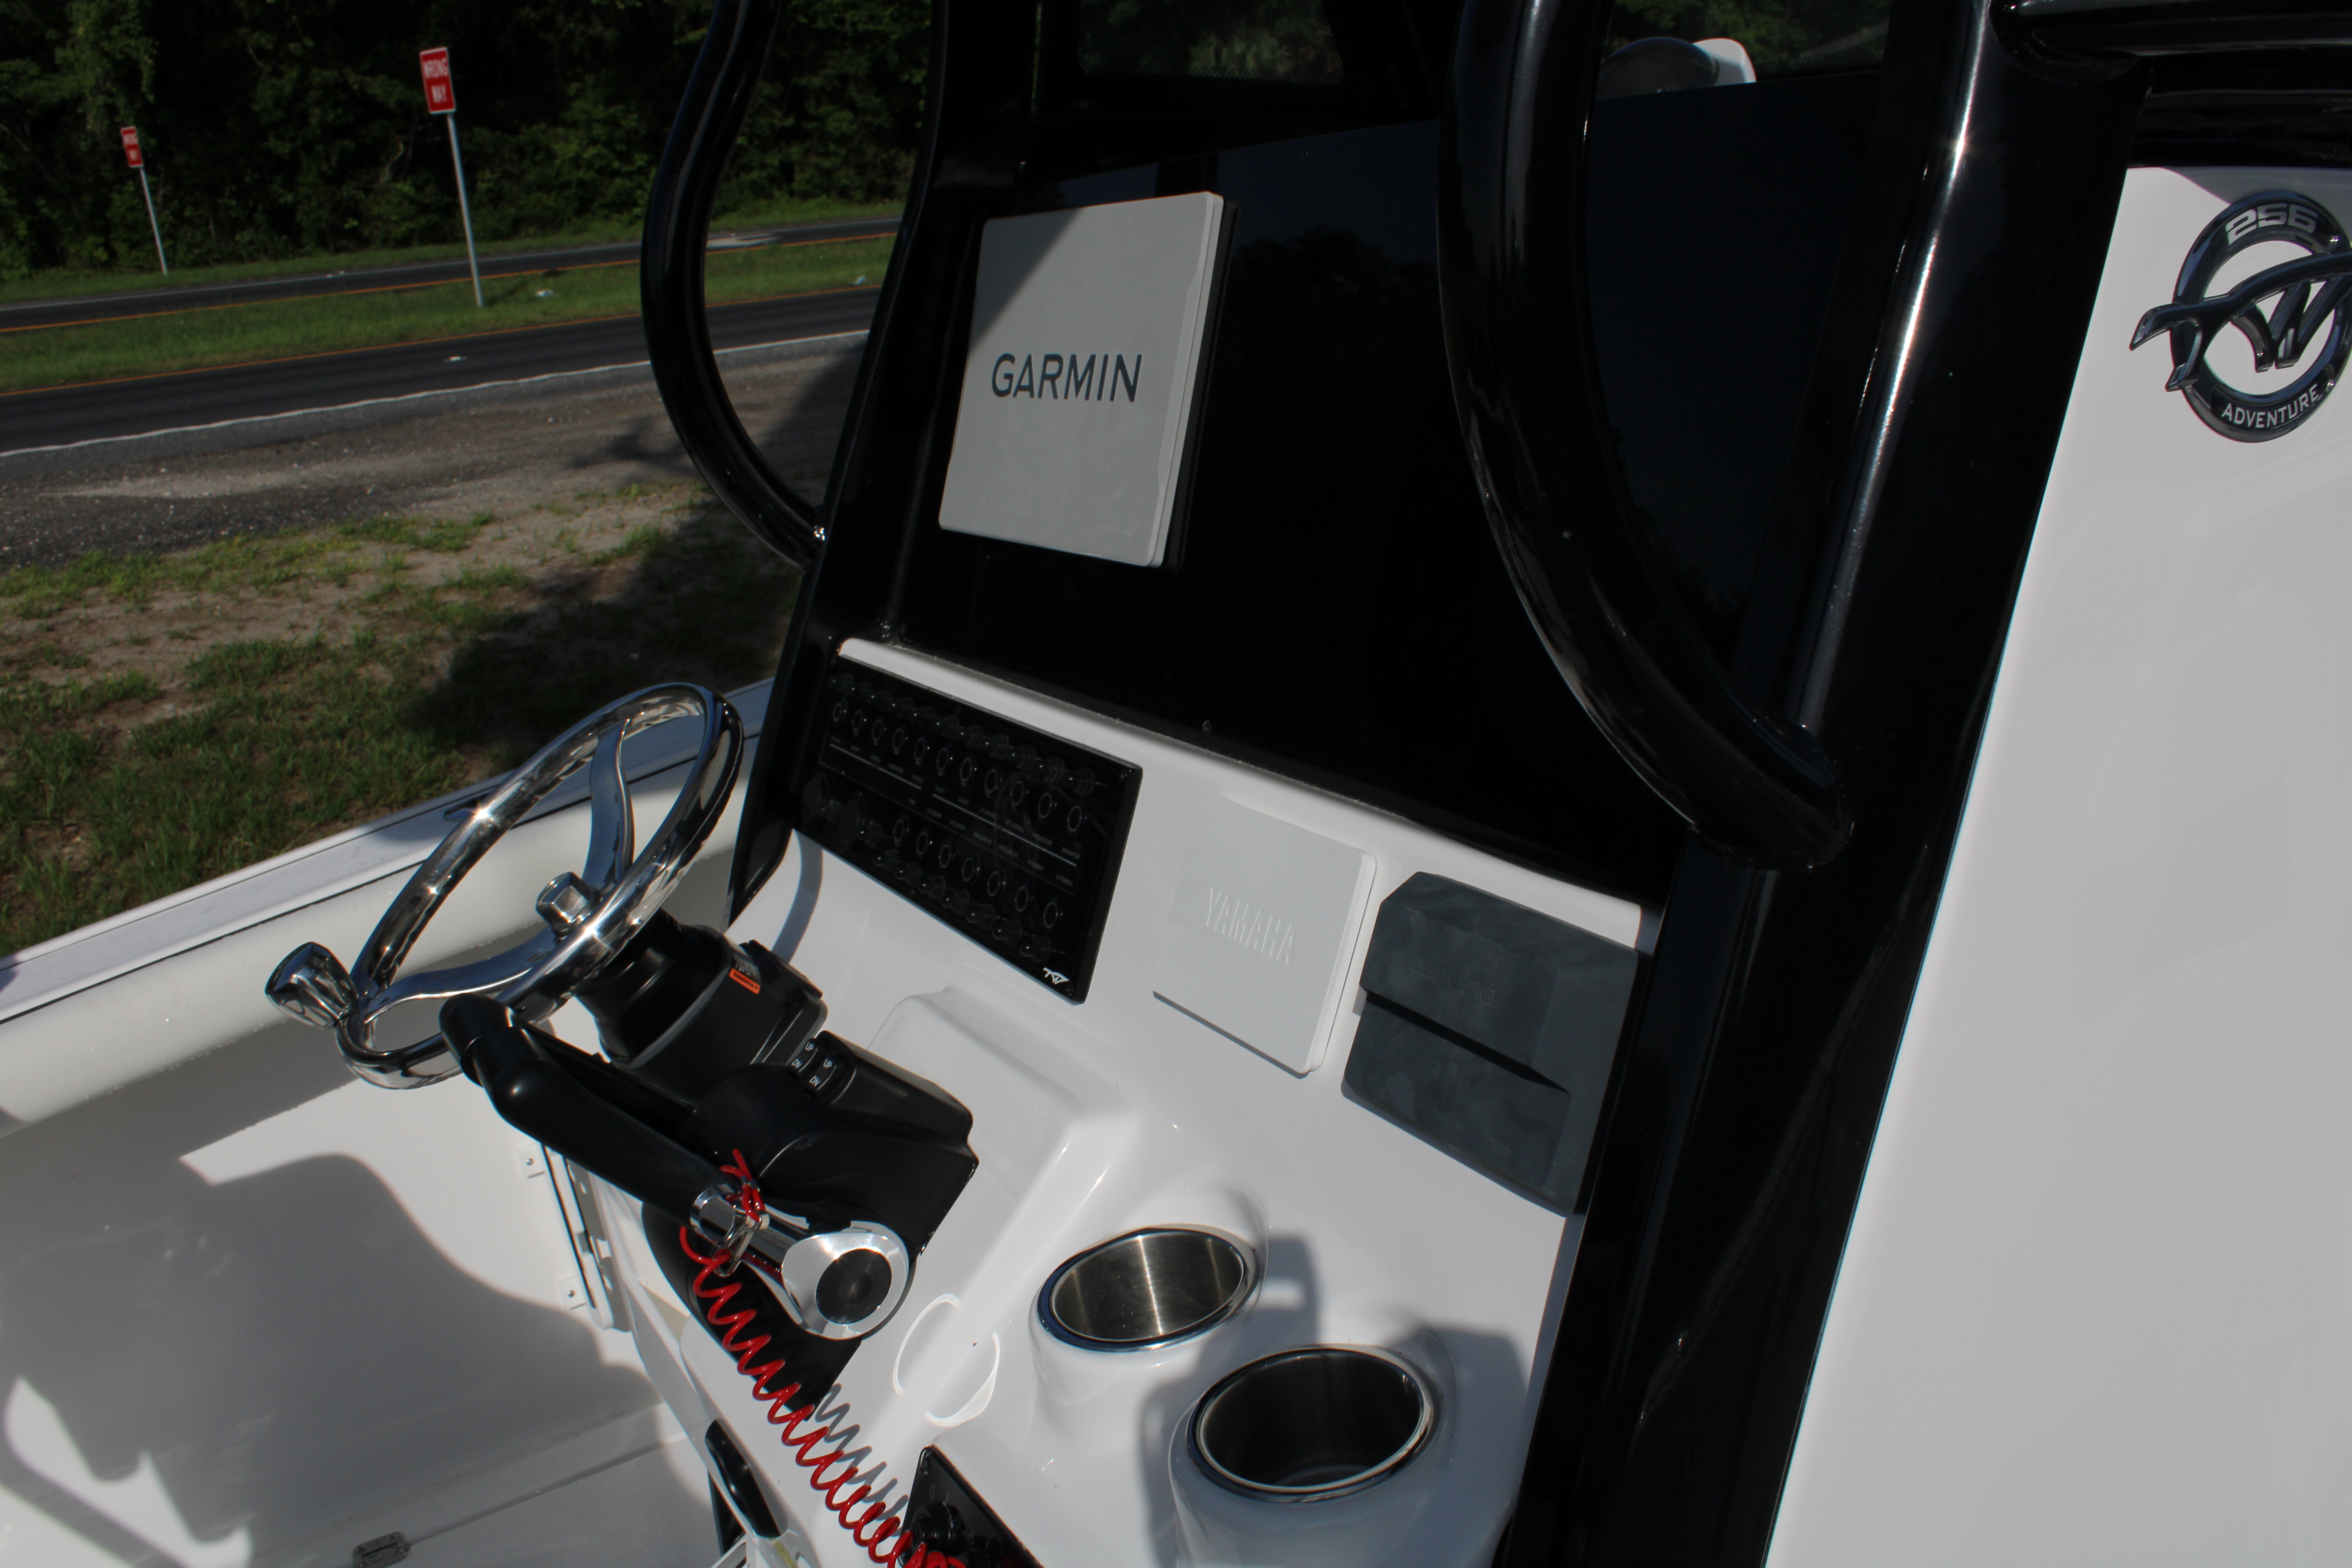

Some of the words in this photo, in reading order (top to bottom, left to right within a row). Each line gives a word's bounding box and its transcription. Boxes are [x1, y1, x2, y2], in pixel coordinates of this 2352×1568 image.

[2225, 203, 2318, 246] 256
[992, 352, 1142, 403] GARMIN
[2221, 383, 2321, 428] ADVENTURE
[1206, 887, 1298, 965] YAMAHA
[805, 1041, 814, 1052] UP
[791, 1058, 803, 1069] DN
[823, 1058, 833, 1069] UP
[809, 1075, 821, 1087] DN
